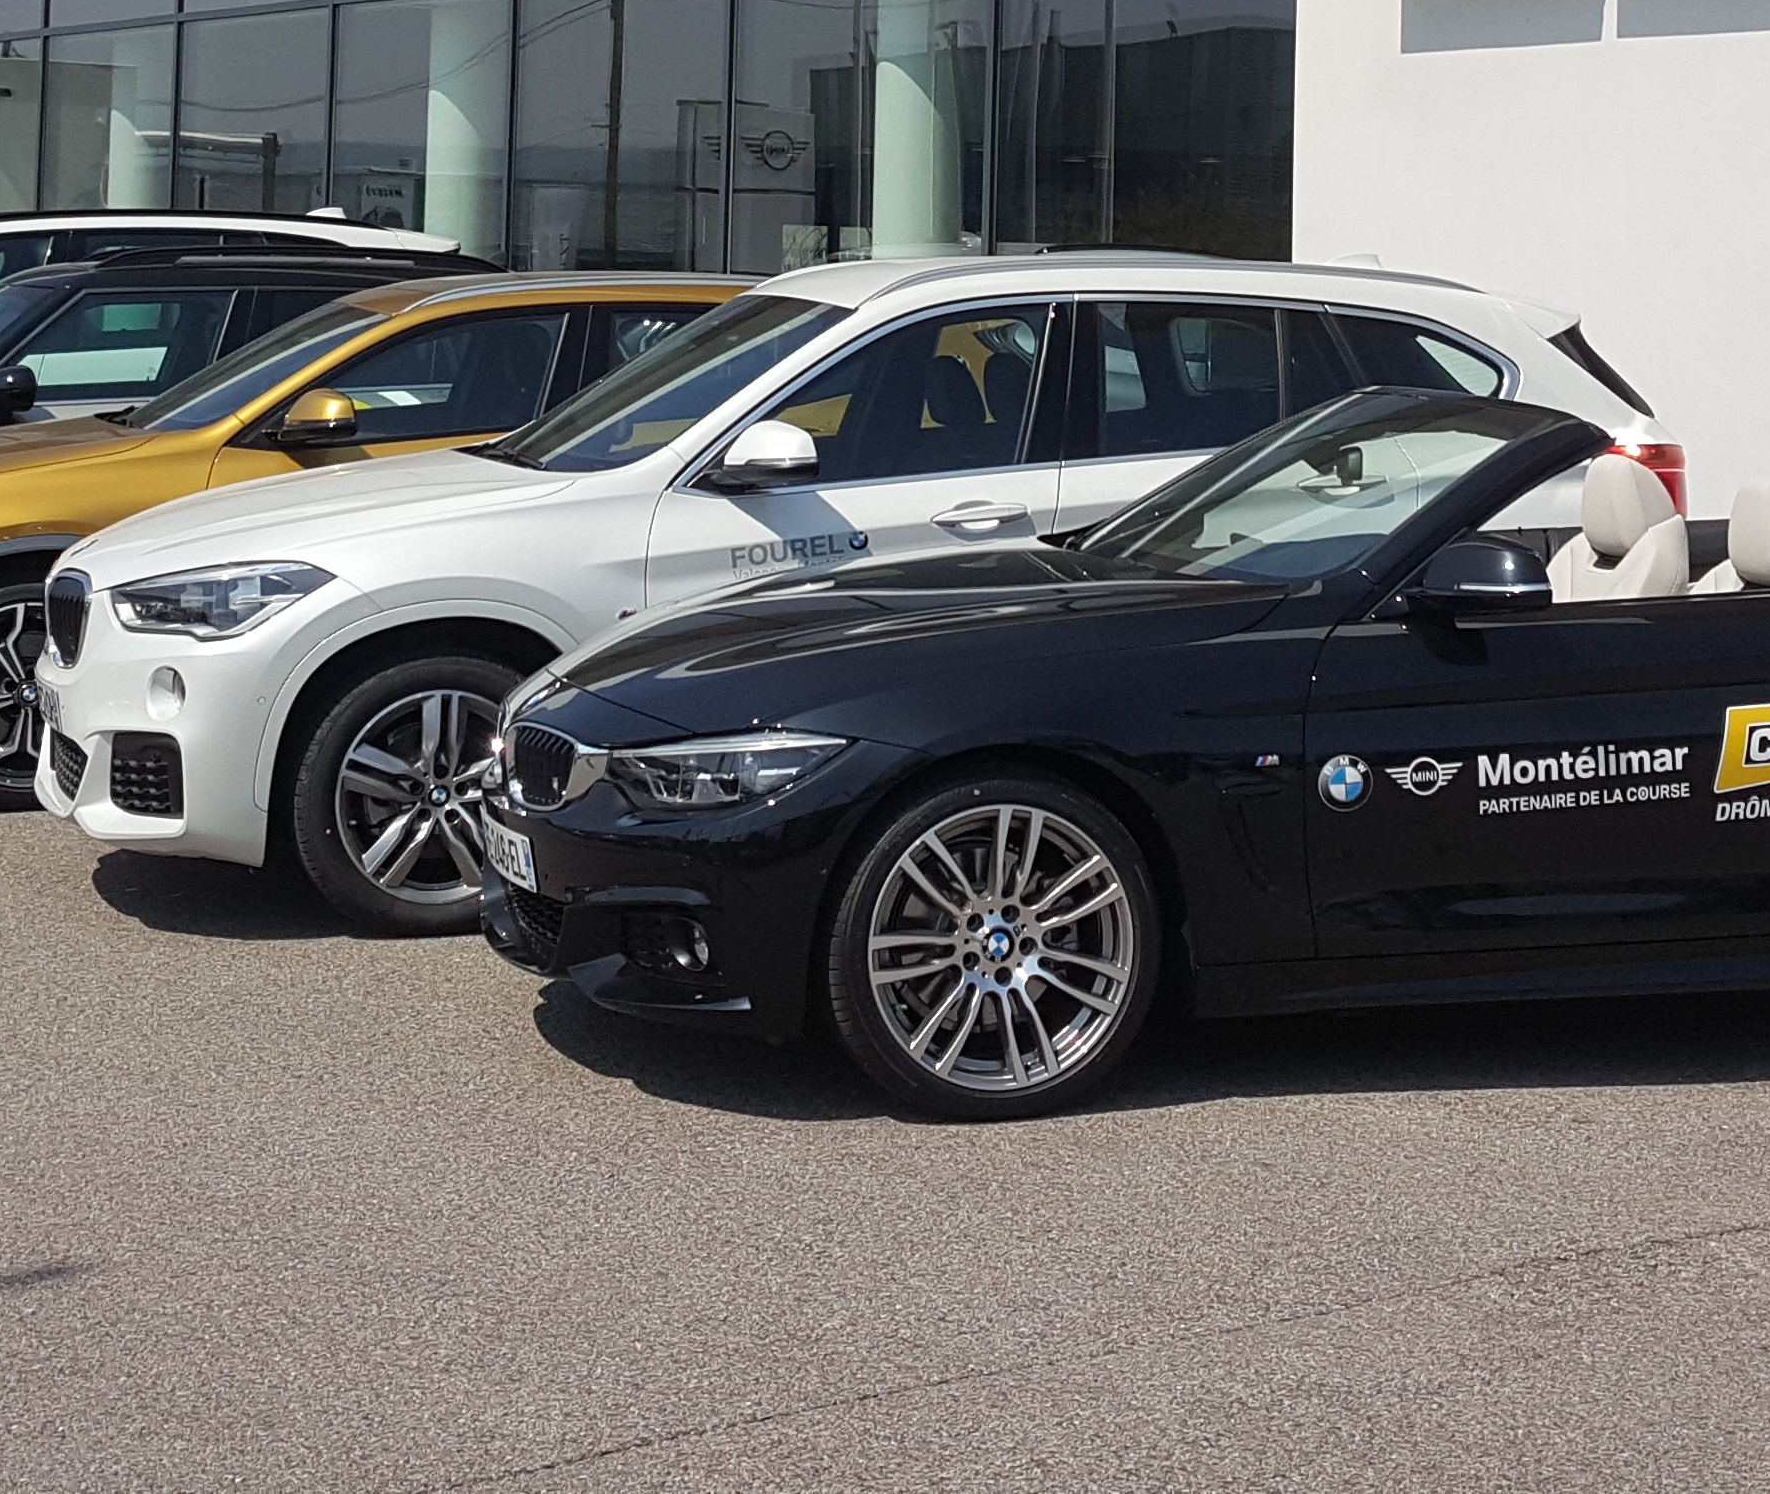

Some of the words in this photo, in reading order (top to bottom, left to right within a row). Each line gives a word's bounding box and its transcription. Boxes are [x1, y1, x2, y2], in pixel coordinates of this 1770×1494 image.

[731, 534, 845, 568] FOUREL
[1411, 770, 1438, 783] MINI
[1477, 744, 1689, 787] Montélimar
[1478, 792, 1576, 815] PARTENAIRE
[1579, 790, 1600, 806] DE
[1603, 788, 1623, 804] LA
[1626, 782, 1691, 802] COURSE
